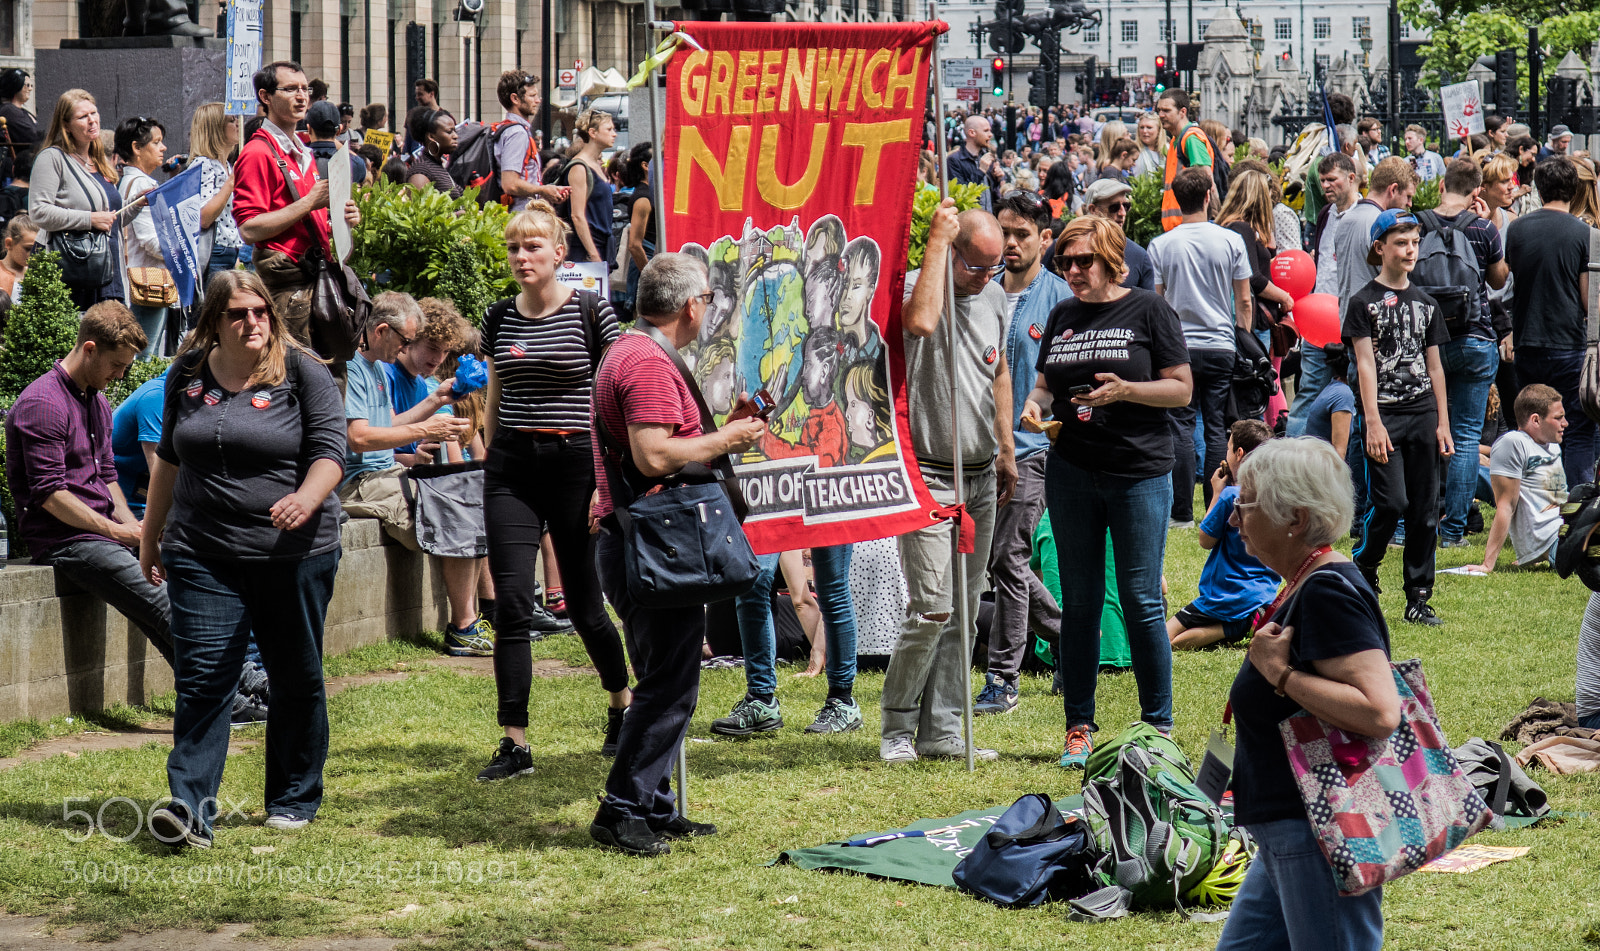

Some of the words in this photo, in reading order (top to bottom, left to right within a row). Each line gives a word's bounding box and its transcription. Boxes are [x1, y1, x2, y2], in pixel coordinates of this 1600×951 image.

[575, 61, 582, 69] H
[681, 47, 924, 116] GREENWICH
[673, 118, 913, 214] NUT
[1096, 328, 1135, 341] EQUALS:
[1062, 342, 1082, 351] RICH
[1082, 340, 1097, 349] GET
[1096, 339, 1128, 348] RICHER
[1056, 352, 1078, 362] POOR
[1079, 350, 1095, 360] GET
[1094, 349, 1130, 360] POORER
[777, 472, 802, 502] OF
[805, 471, 904, 508] TEACHERS
